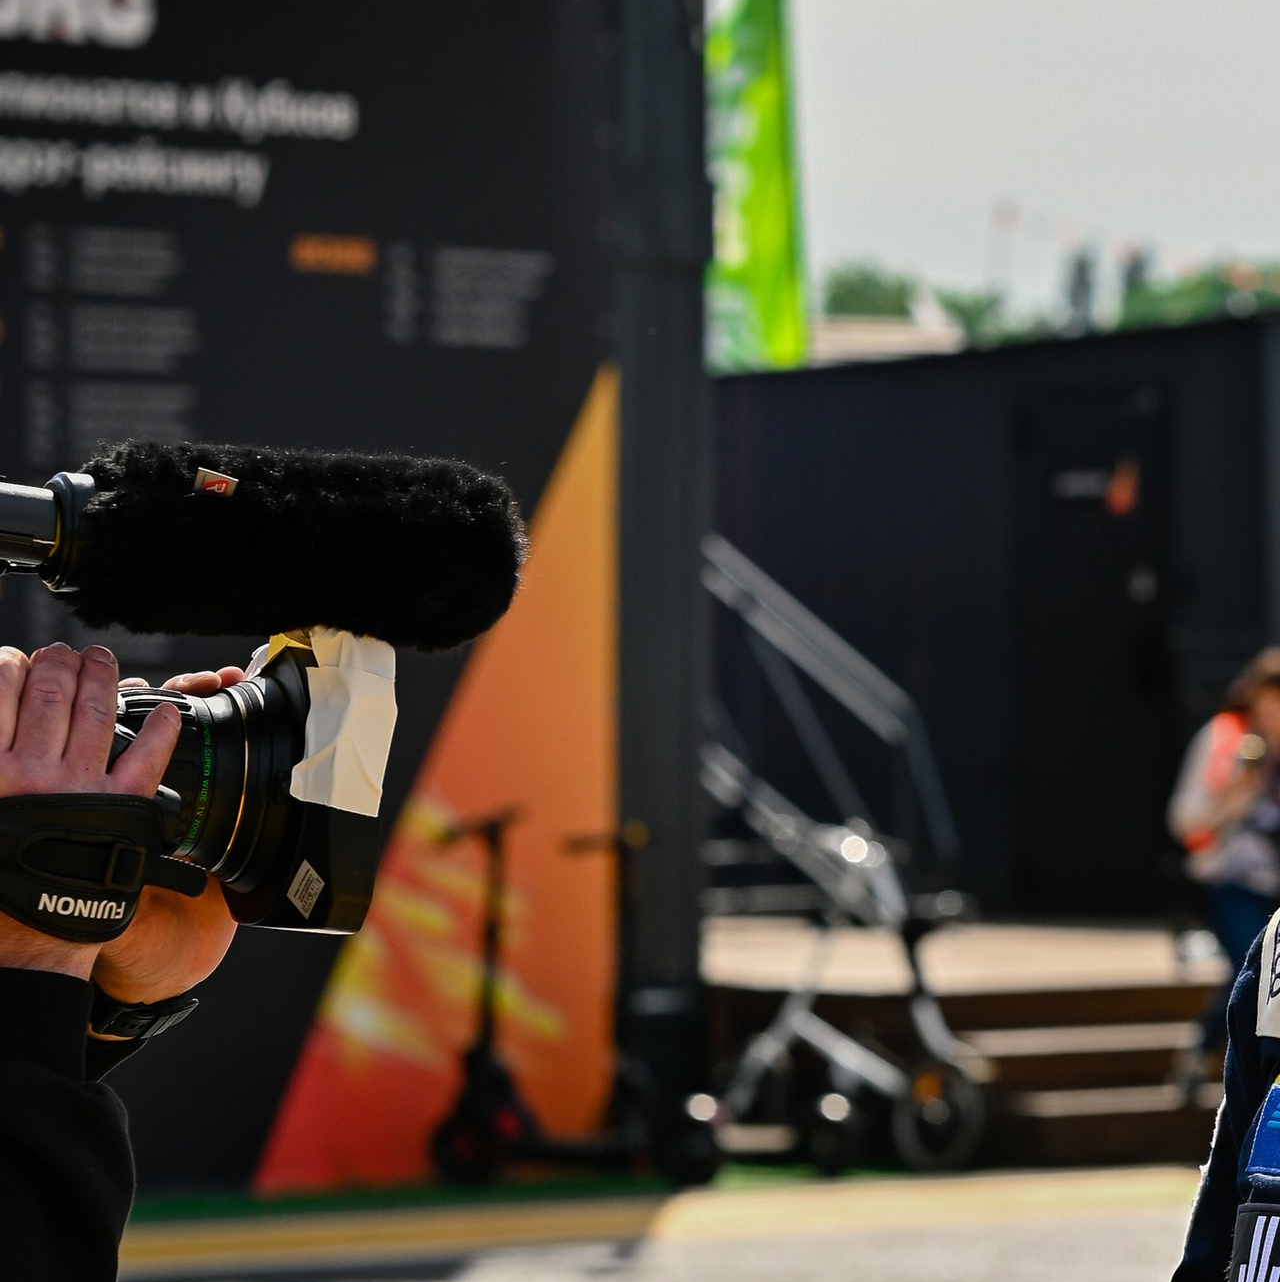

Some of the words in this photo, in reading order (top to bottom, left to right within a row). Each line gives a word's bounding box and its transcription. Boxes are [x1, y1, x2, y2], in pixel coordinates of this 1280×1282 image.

[203, 747, 212, 776] SUPER
[199, 779, 210, 802] WIDE
[196, 805, 206, 817] TV
[37, 892, 126, 920] FUJINON
